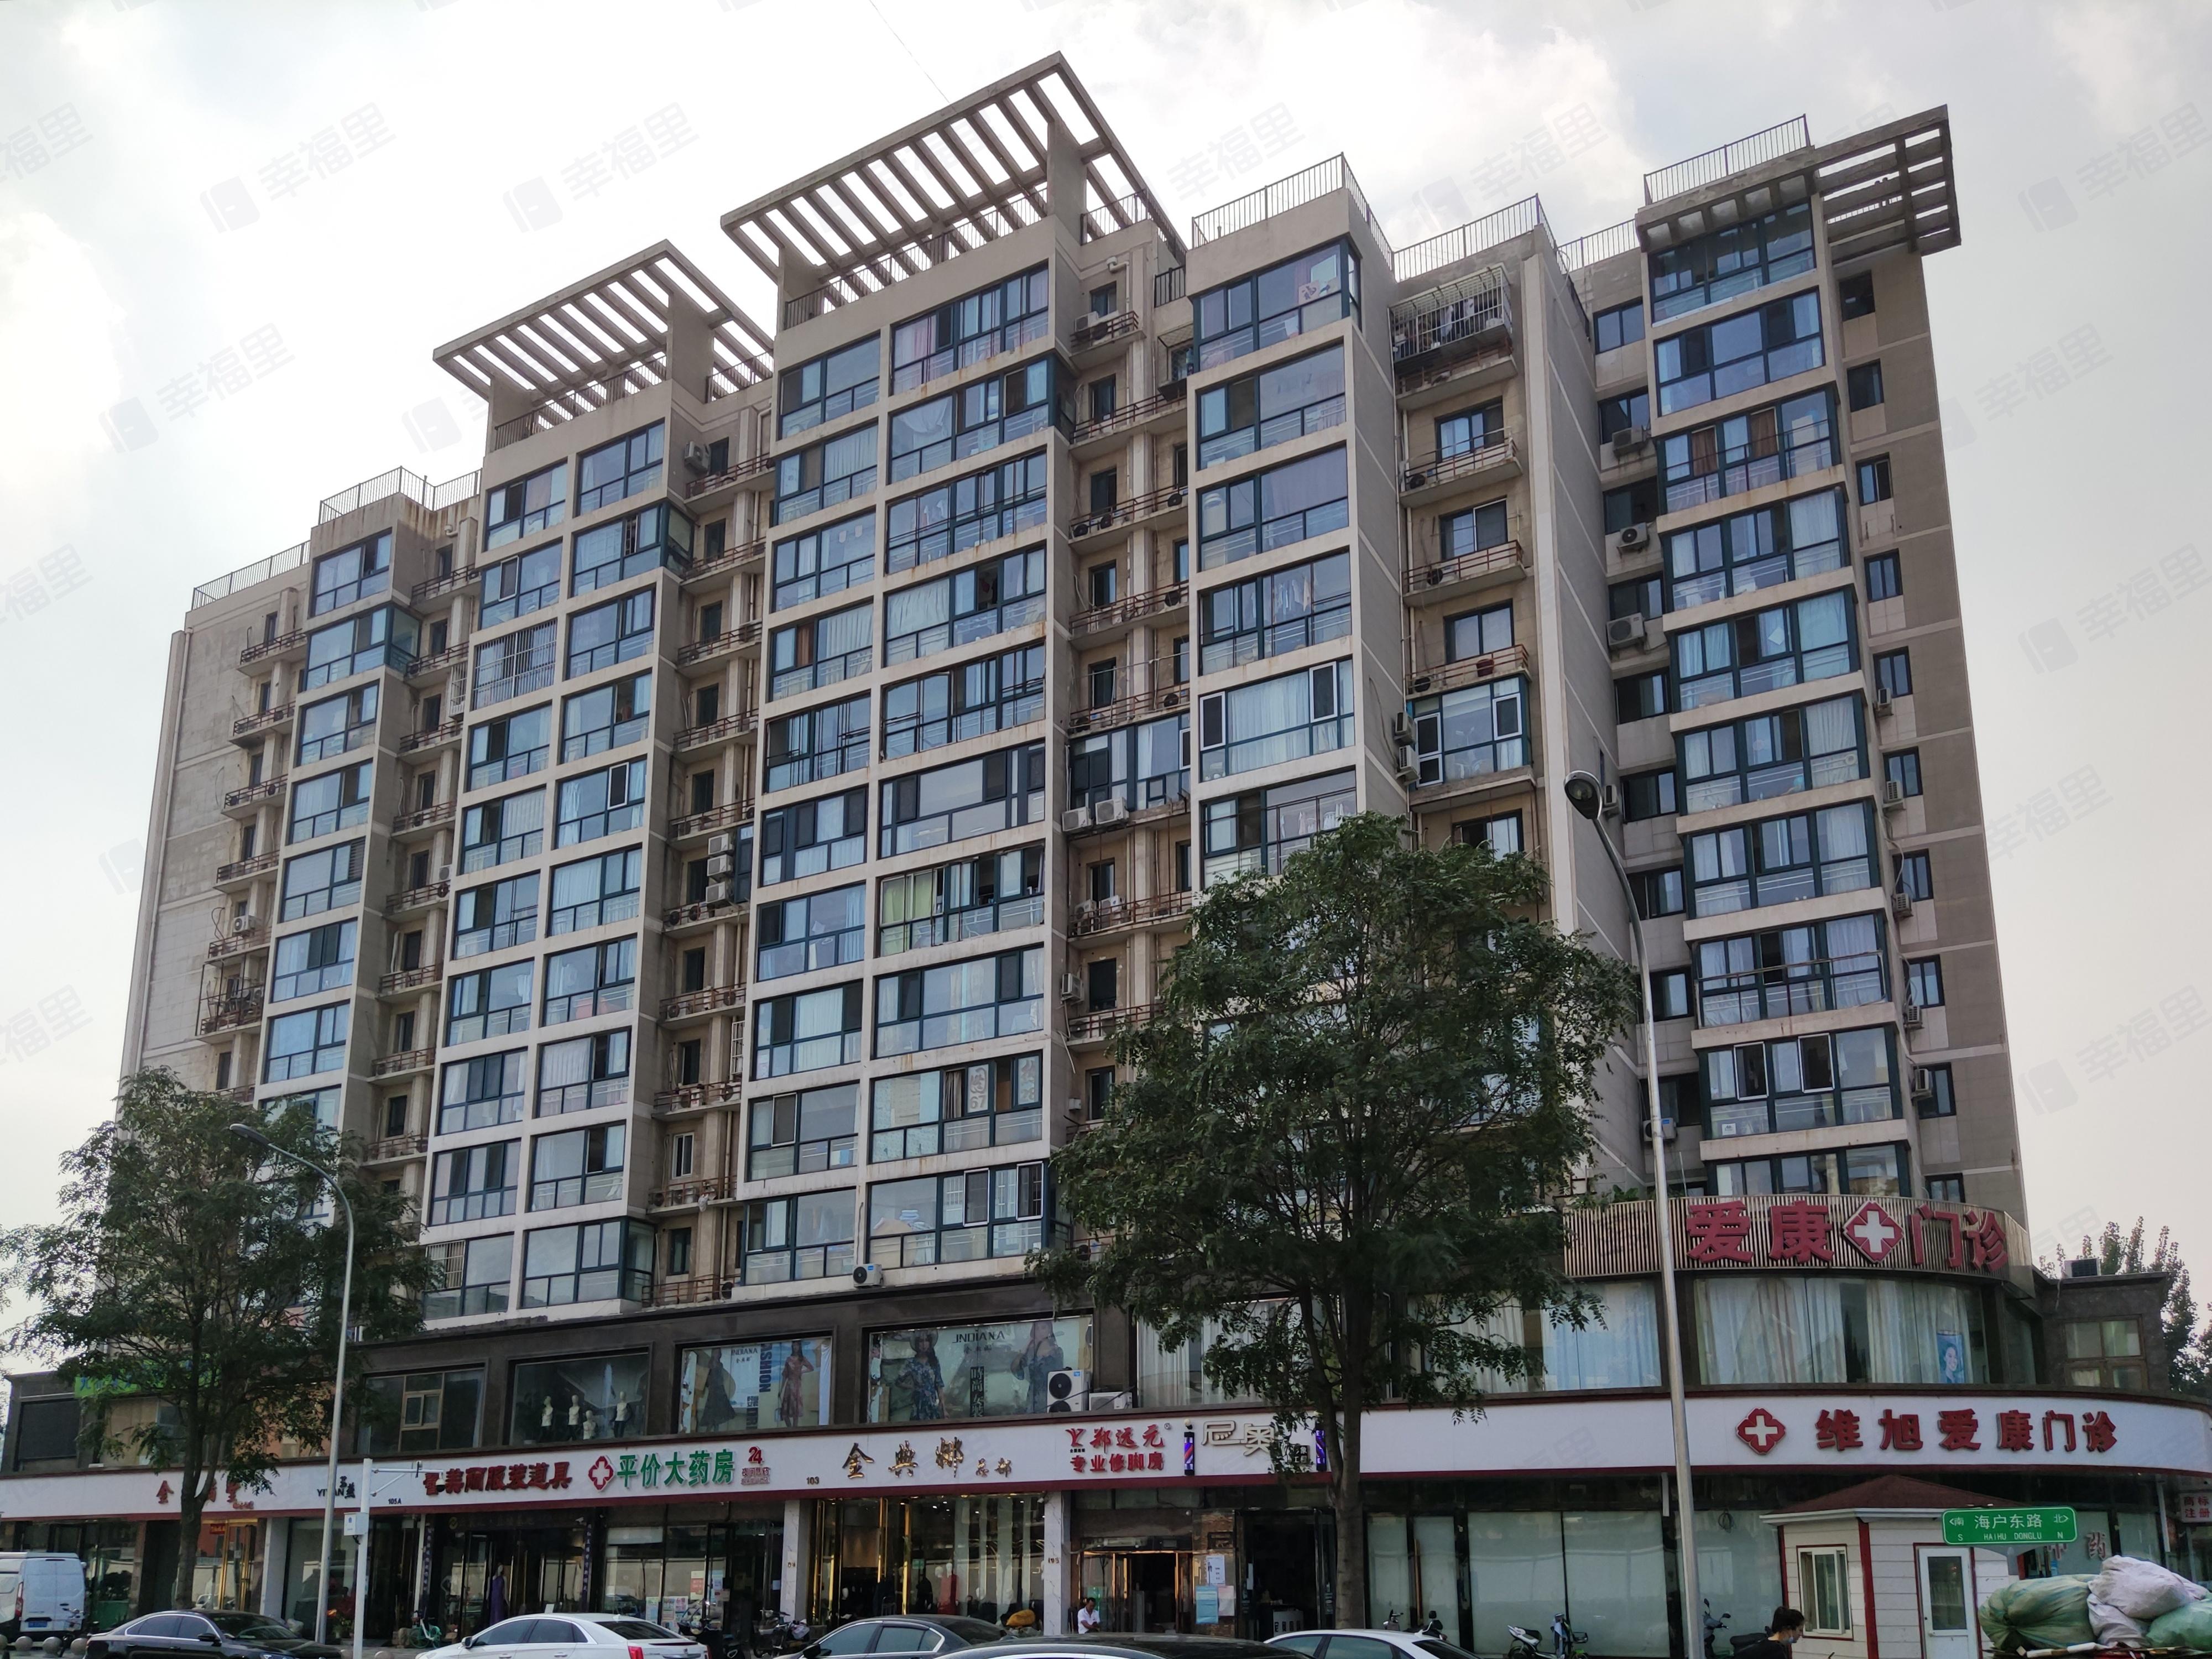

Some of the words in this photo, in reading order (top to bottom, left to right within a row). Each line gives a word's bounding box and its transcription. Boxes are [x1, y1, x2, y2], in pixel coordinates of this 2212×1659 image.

[1686, 1199, 1835, 1265] 爱康
[1908, 1203, 2008, 1272] 门诊
[1089, 1423, 1165, 1453] 郑远元
[1815, 1408, 2117, 1452] 维旭爱康门诊
[748, 1446, 763, 1464] 24
[1070, 1451, 1164, 1473] 专业修脚房
[617, 1448, 735, 1488] 平价大药房
[806, 1476, 820, 1485] 103
[1954, 1517, 1964, 1526] 南
[1974, 1513, 2043, 1530] 海户东路
[2053, 1513, 2064, 1524] 北
[2013, 1532, 2042, 1540] DONGLU
